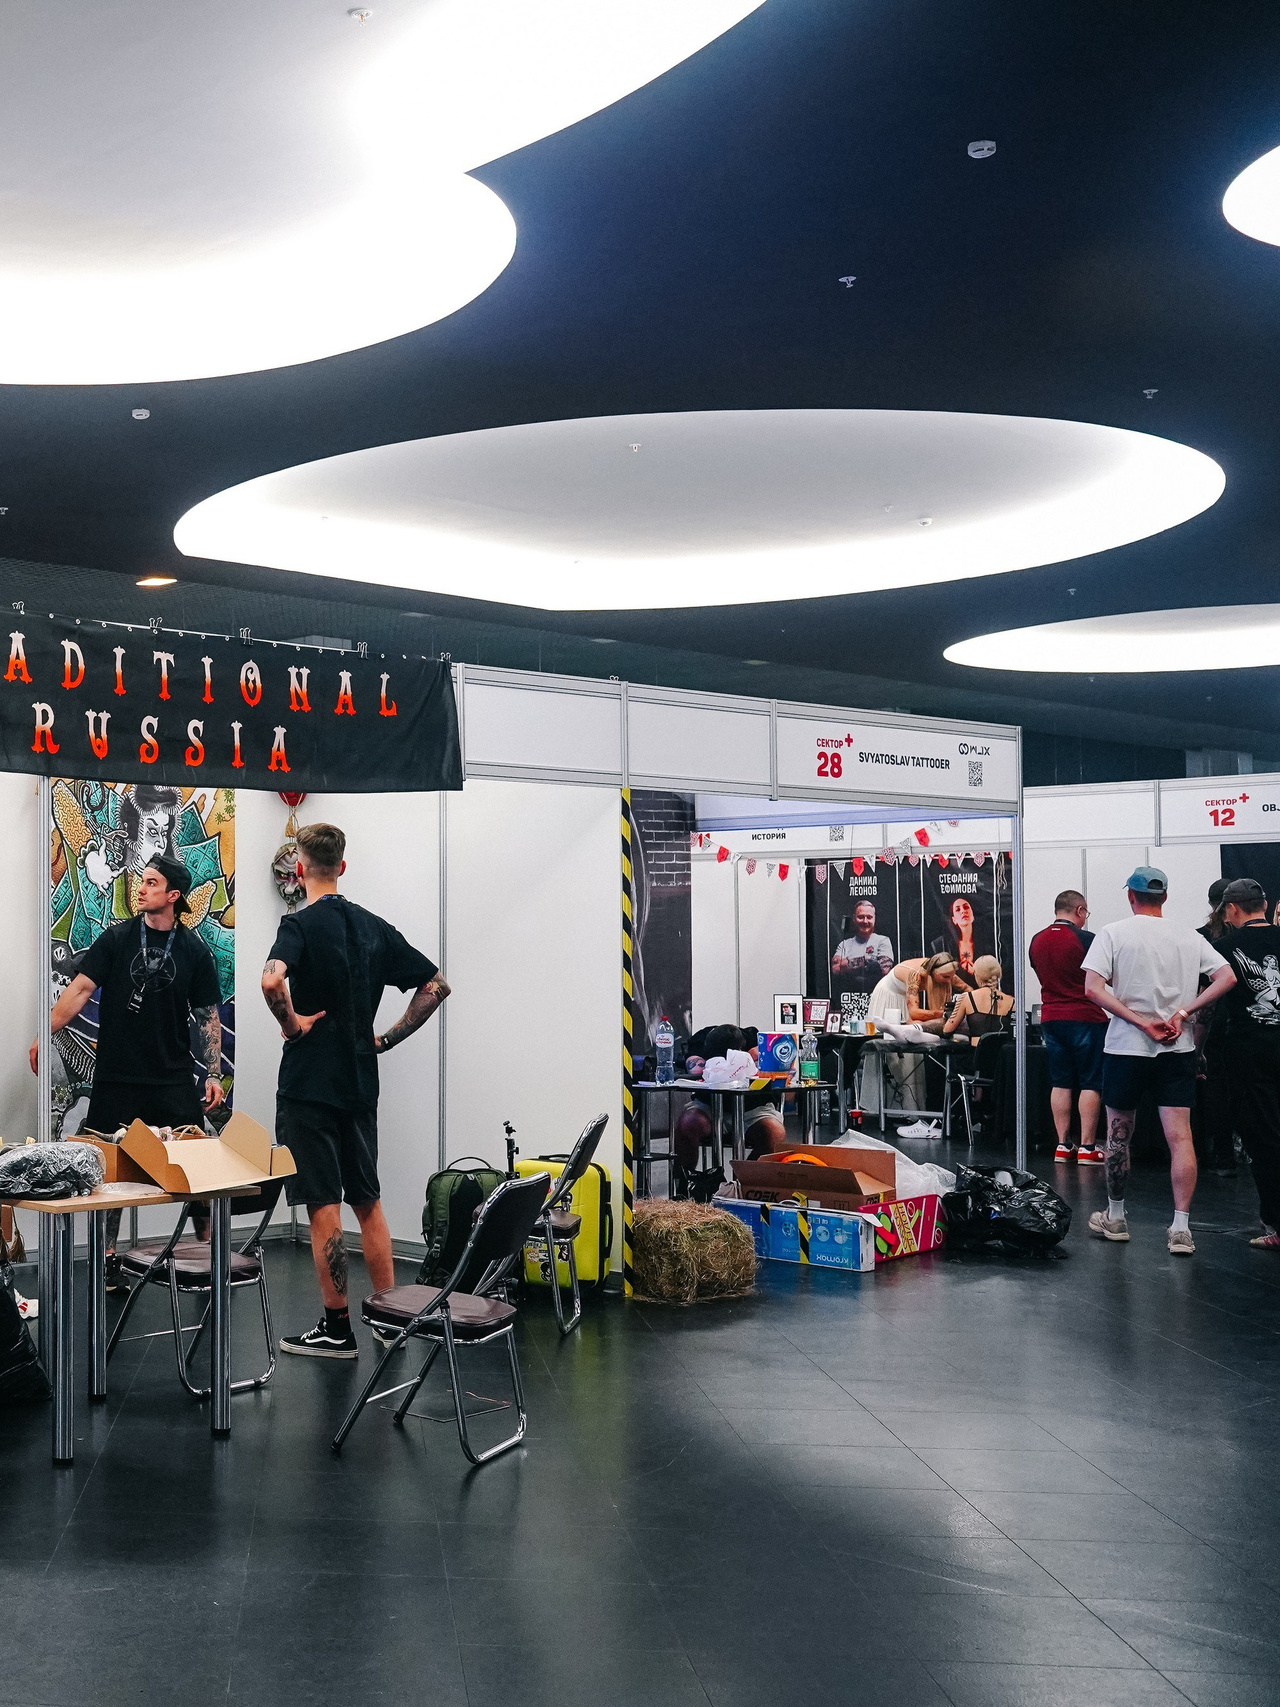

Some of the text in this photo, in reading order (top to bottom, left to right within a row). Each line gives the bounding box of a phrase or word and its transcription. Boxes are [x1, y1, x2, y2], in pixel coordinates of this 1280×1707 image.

[31, 701, 291, 772] RUSSIA
[816, 738, 844, 749] СЕКТОР
[816, 751, 843, 779] 28
[858, 751, 951, 770] SVYATOSLAV TATTOOER
[1204, 798, 1237, 807] СЕКТОР
[1208, 808, 1236, 827] 12
[751, 832, 787, 841] ИСТОРИЯ
[849, 876, 877, 887] ДАНИИЛ
[938, 873, 978, 885] СТЕФАНИЯ
[849, 886, 878, 897] ЛЕОНОВ
[940, 883, 978, 894] ЕФИМОВА
